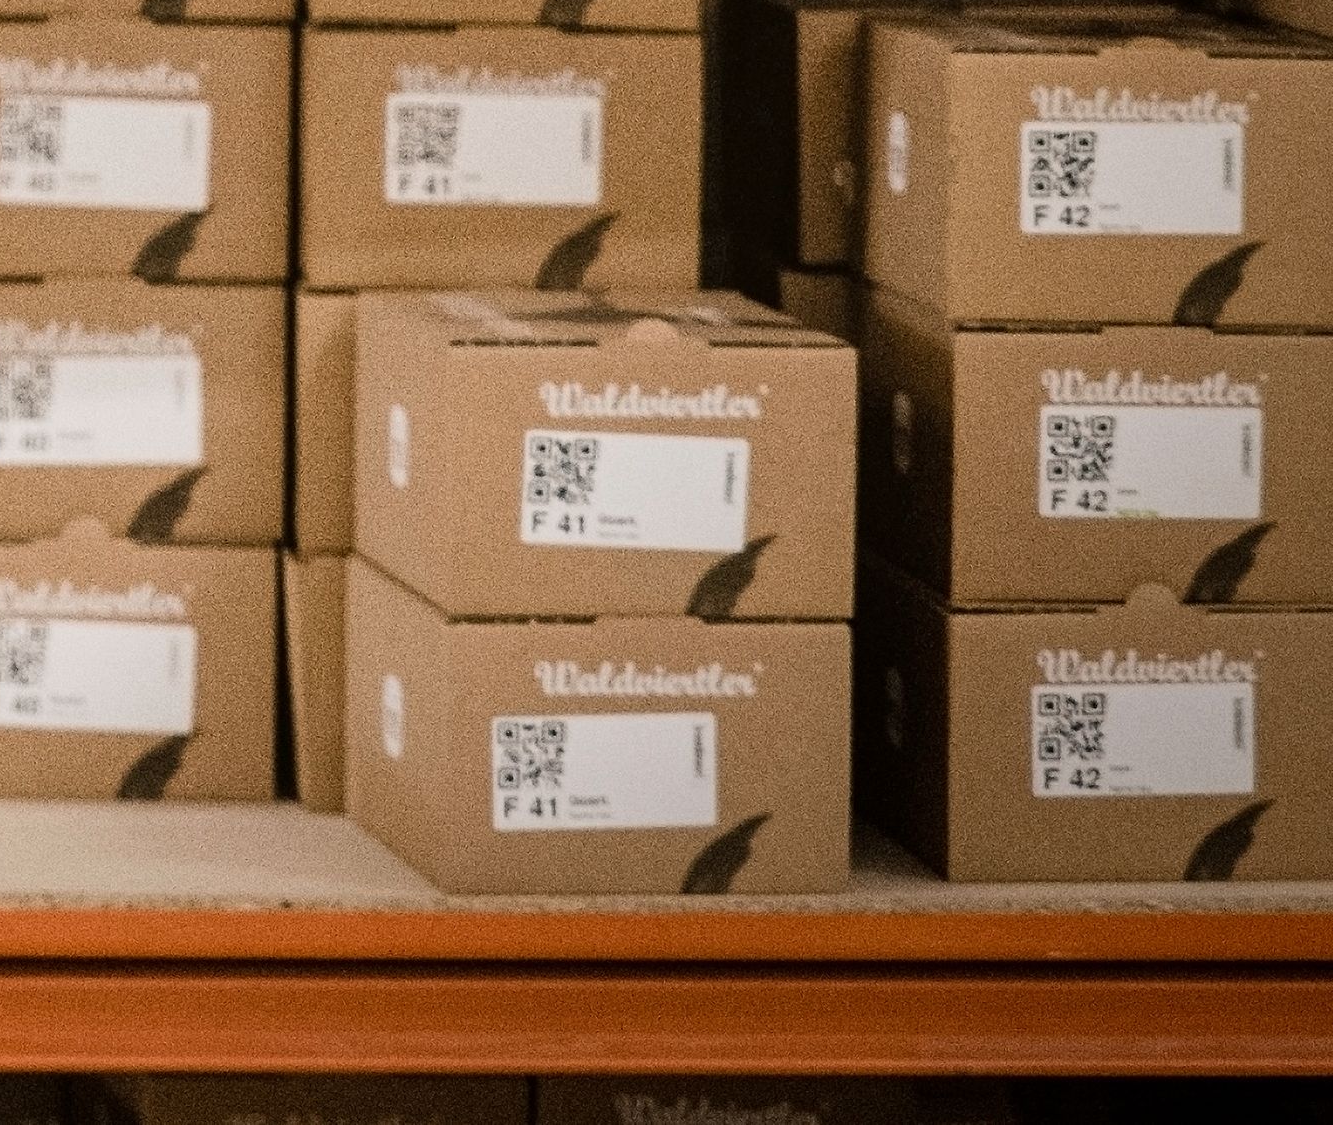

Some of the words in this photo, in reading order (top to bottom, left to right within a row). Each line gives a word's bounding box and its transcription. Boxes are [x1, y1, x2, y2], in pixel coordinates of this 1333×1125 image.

[1030, 84, 1251, 122] Waldviertler
[1033, 204, 1050, 226] F
[1059, 204, 1091, 228] 42
[539, 380, 763, 418] Waldviertler
[1040, 369, 1263, 403] Waldviertler
[1051, 489, 1067, 511] F
[1076, 489, 1108, 512] 42
[531, 510, 547, 534] F
[558, 512, 586, 535] 41
[535, 659, 757, 697] Waldviertler
[1036, 648, 1258, 682] Waldviertler
[1043, 767, 1060, 790] F
[1069, 767, 1101, 790] 42
[503, 796, 518, 818] F
[530, 796, 557, 818] 41
